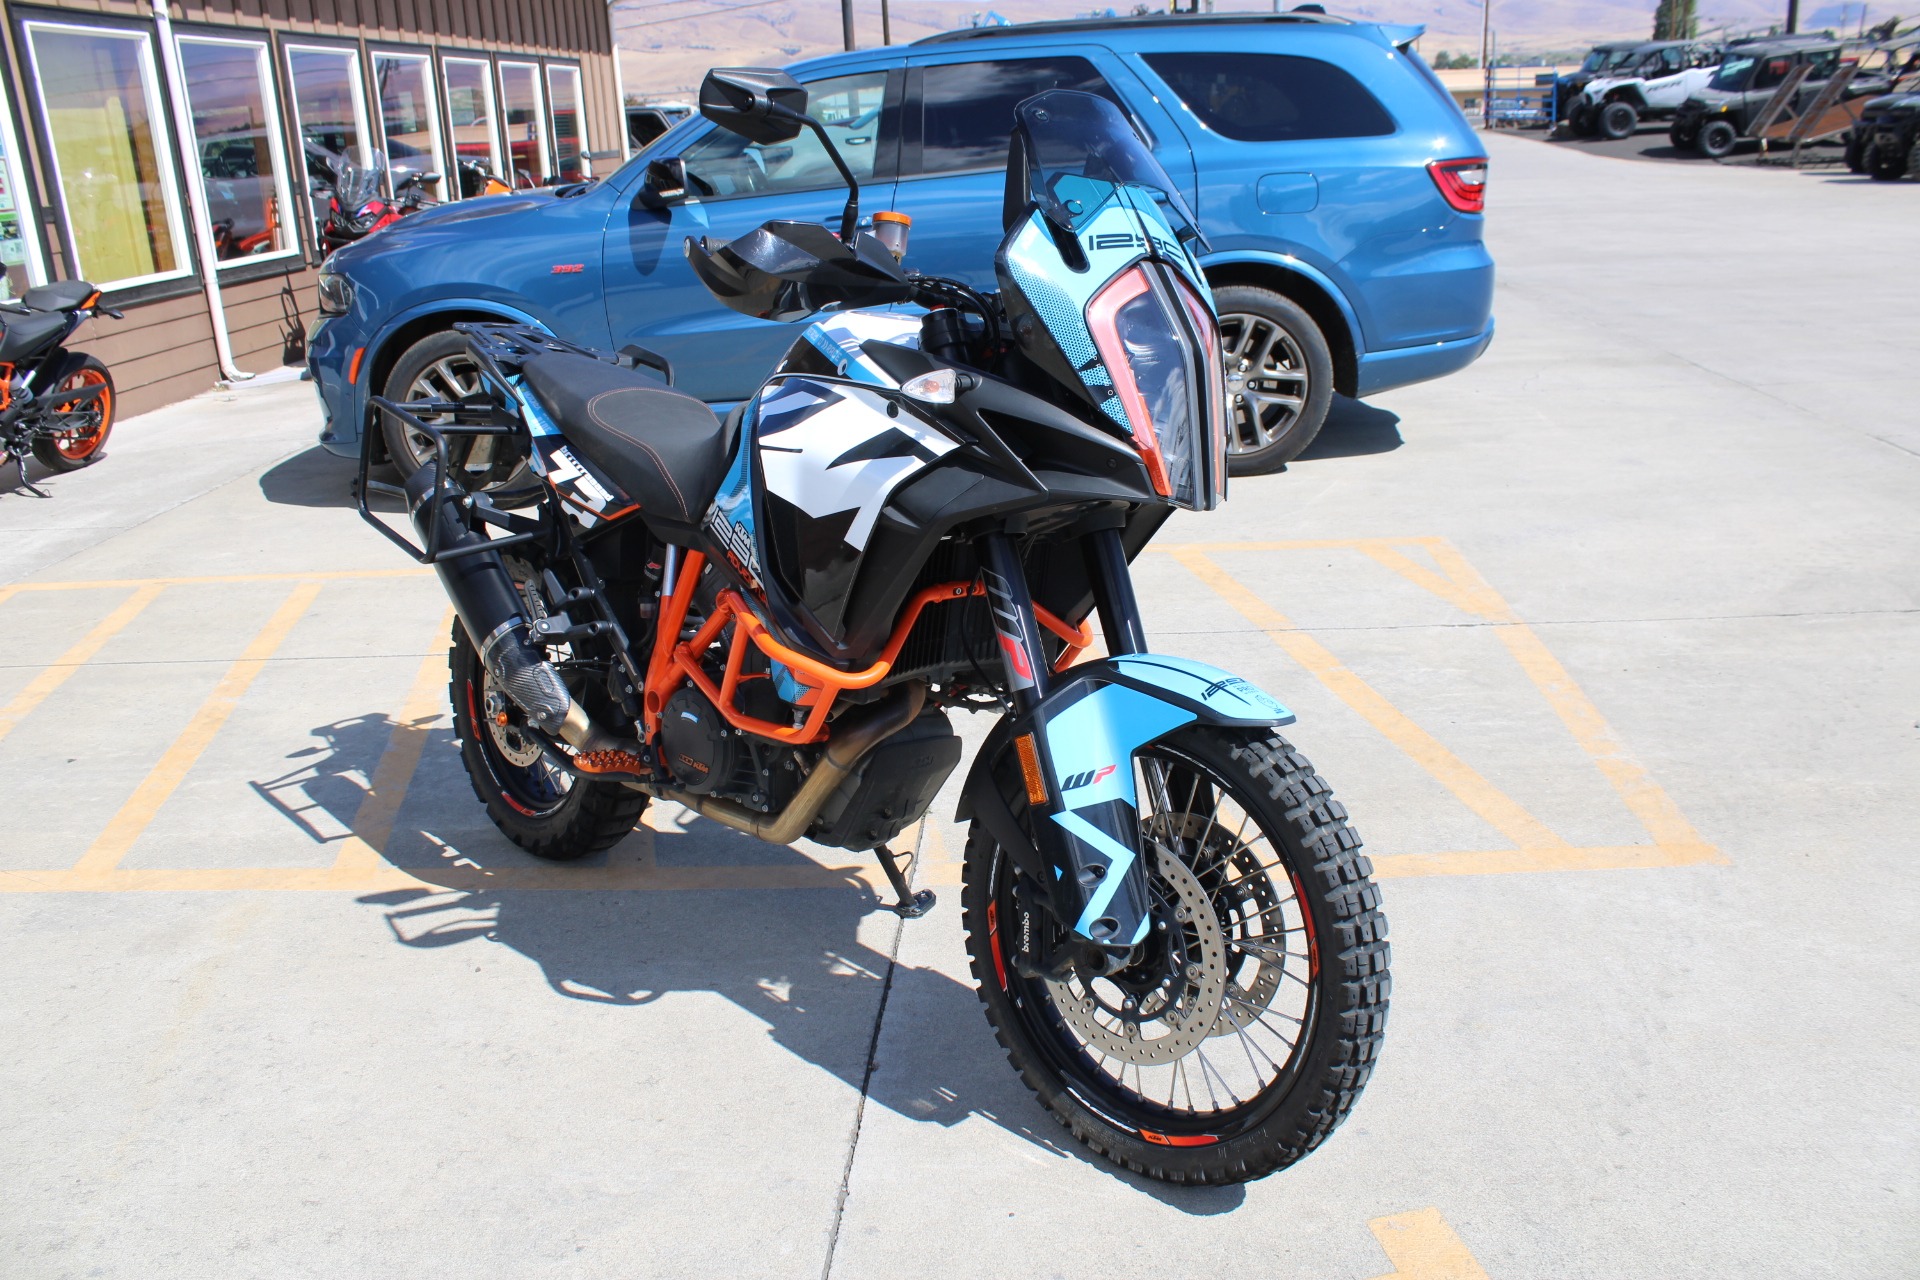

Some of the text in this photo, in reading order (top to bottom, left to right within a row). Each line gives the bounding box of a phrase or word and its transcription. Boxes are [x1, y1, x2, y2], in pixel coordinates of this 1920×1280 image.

[551, 263, 585, 274] 392
[734, 521, 751, 550] KTM
[1060, 764, 1117, 793] WP
[1021, 911, 1030, 953] brembo
